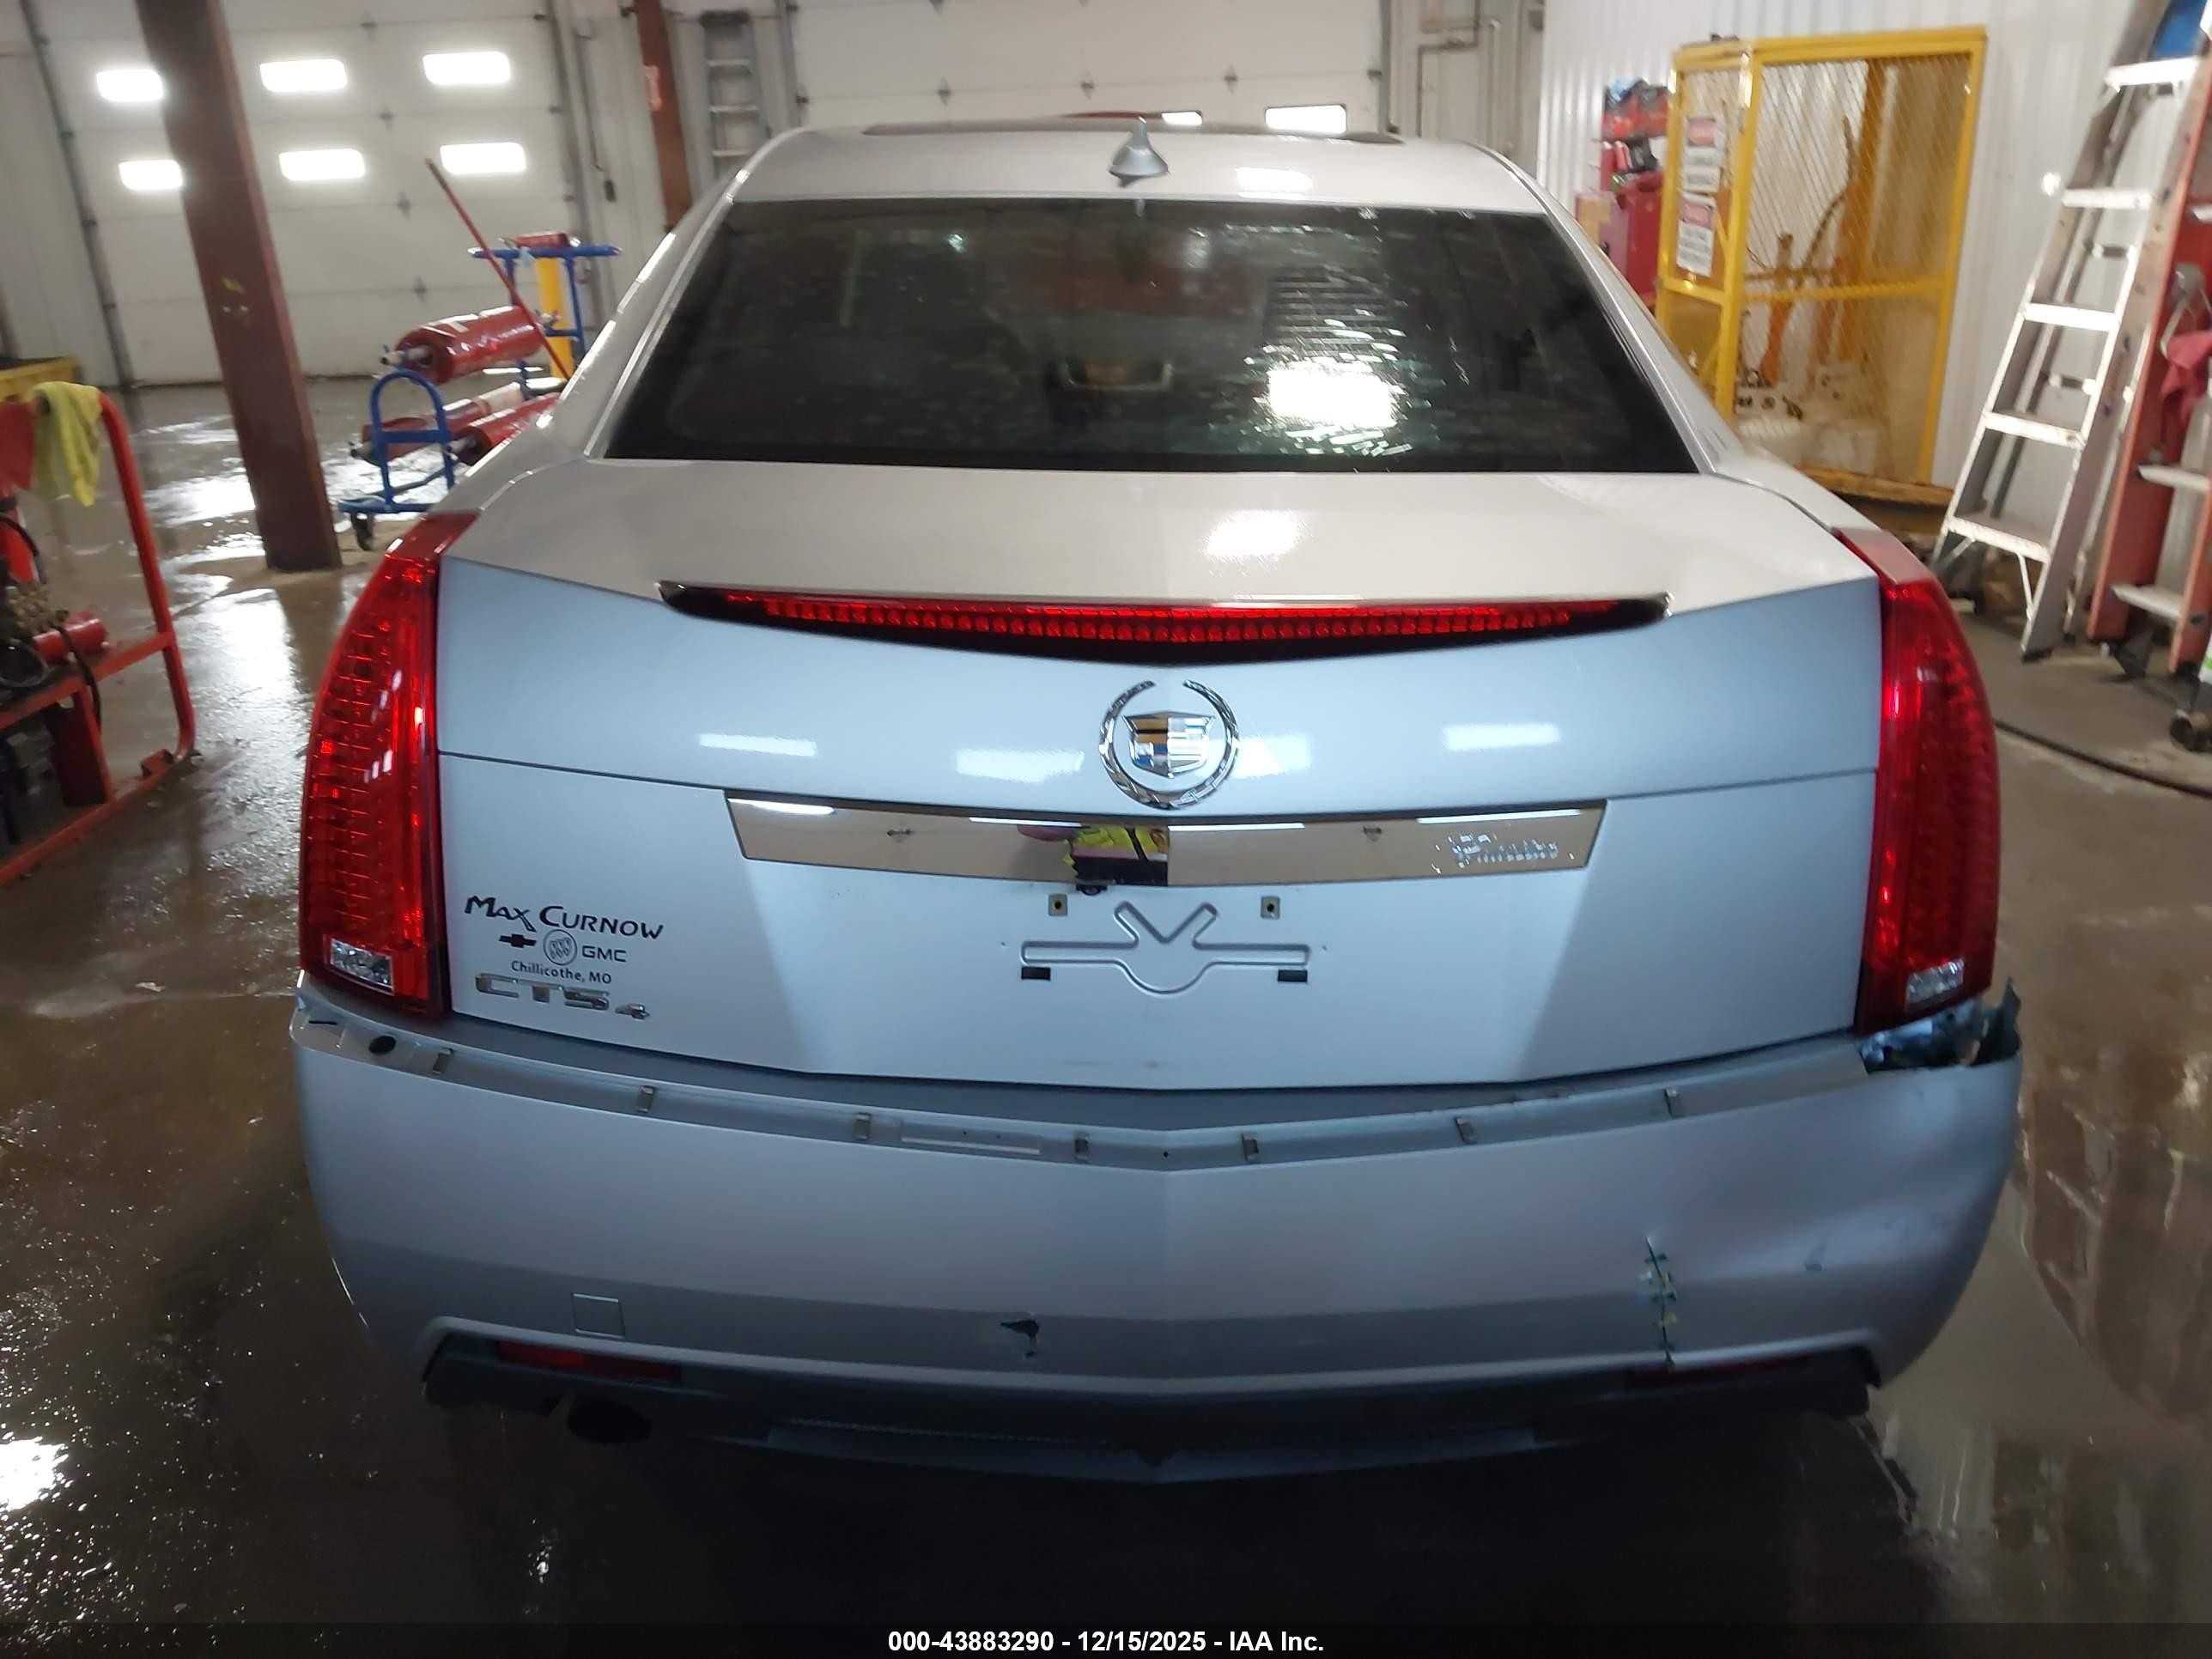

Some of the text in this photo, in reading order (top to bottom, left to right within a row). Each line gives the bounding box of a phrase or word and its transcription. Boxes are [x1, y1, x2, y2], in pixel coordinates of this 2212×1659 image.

[581, 945, 627, 963] GMC
[511, 960, 611, 984] Chillicothe, MO
